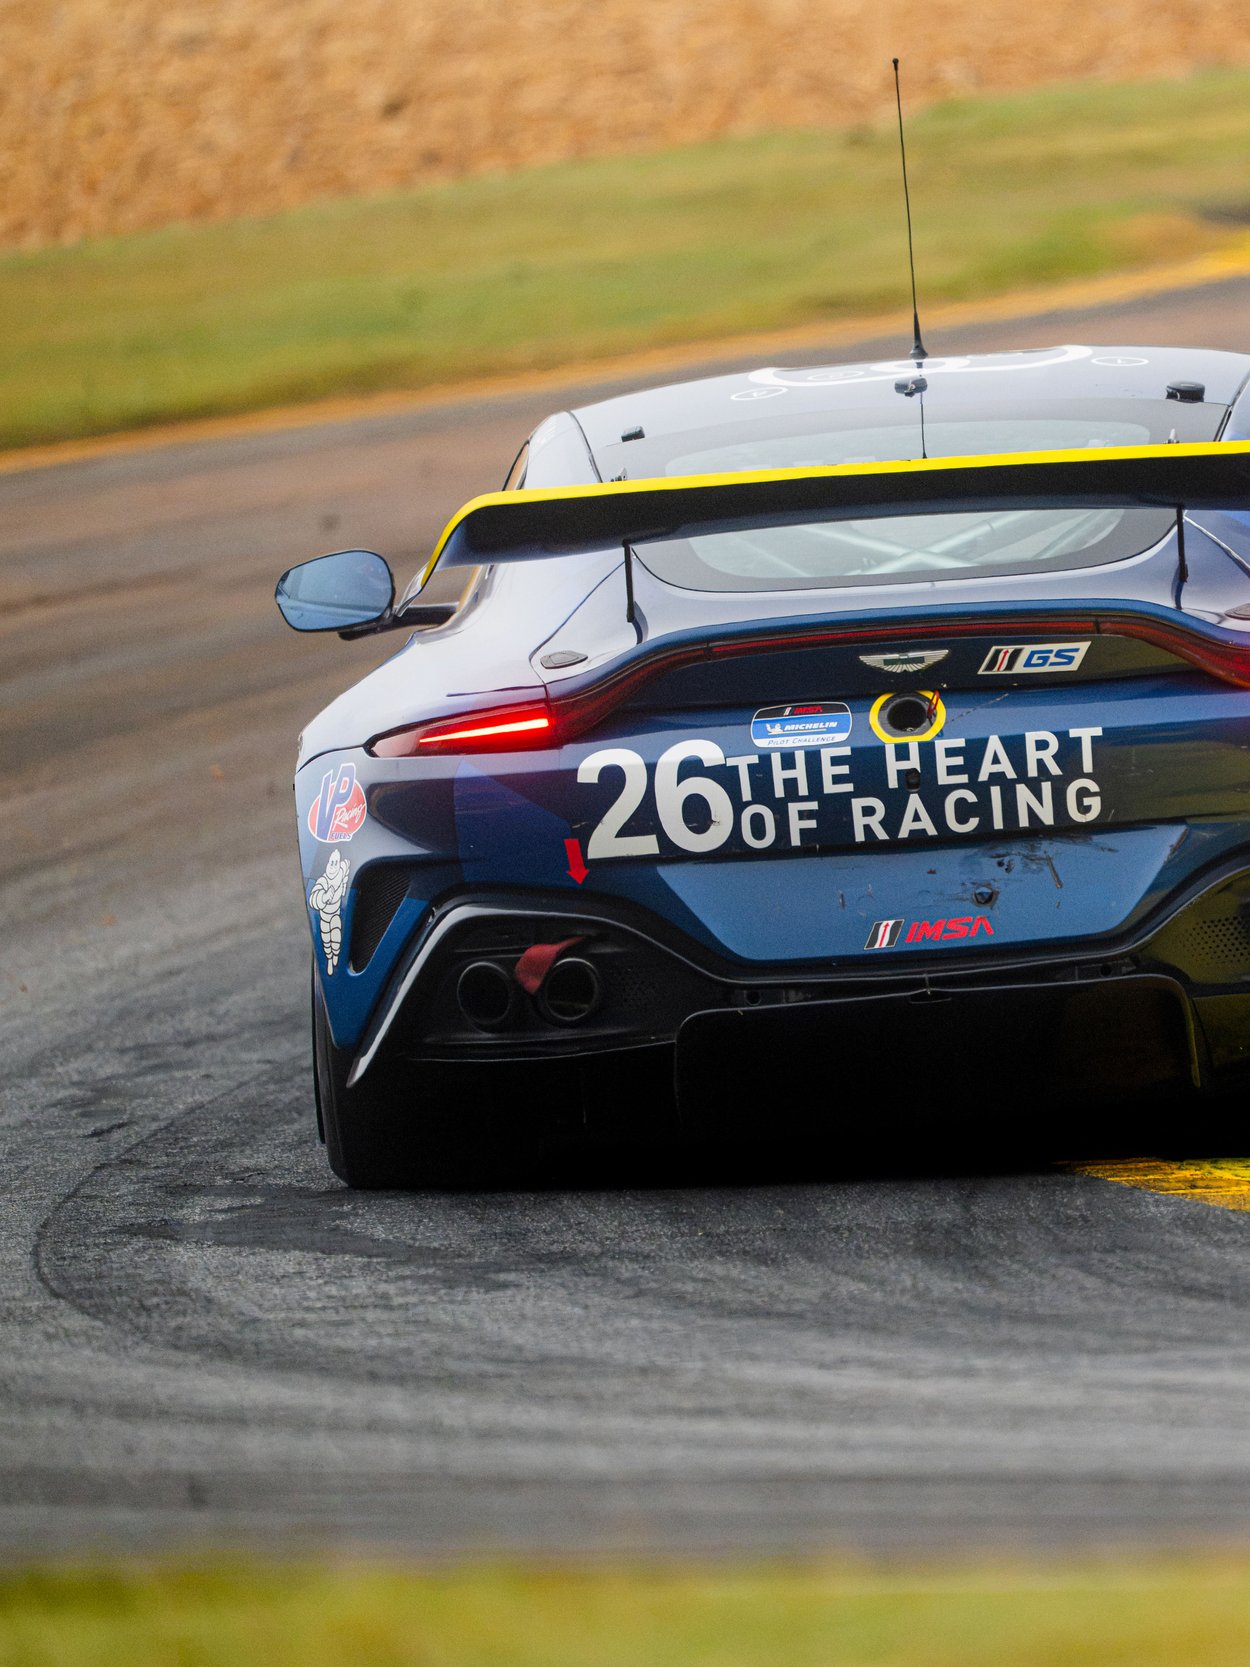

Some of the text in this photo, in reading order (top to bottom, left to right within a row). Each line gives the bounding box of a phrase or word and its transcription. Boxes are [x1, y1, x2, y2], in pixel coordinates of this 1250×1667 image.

[1023, 648, 1080, 668] GS
[794, 706, 822, 714] IMSA
[784, 722, 838, 731] MICHELIN
[726, 727, 1103, 801] THE HEART
[316, 763, 356, 841] VP
[576, 739, 734, 860] 26
[741, 778, 1102, 848] OF RACING
[333, 803, 366, 830] Racing
[330, 832, 352, 840] FUELS
[905, 915, 995, 943] IMSA
